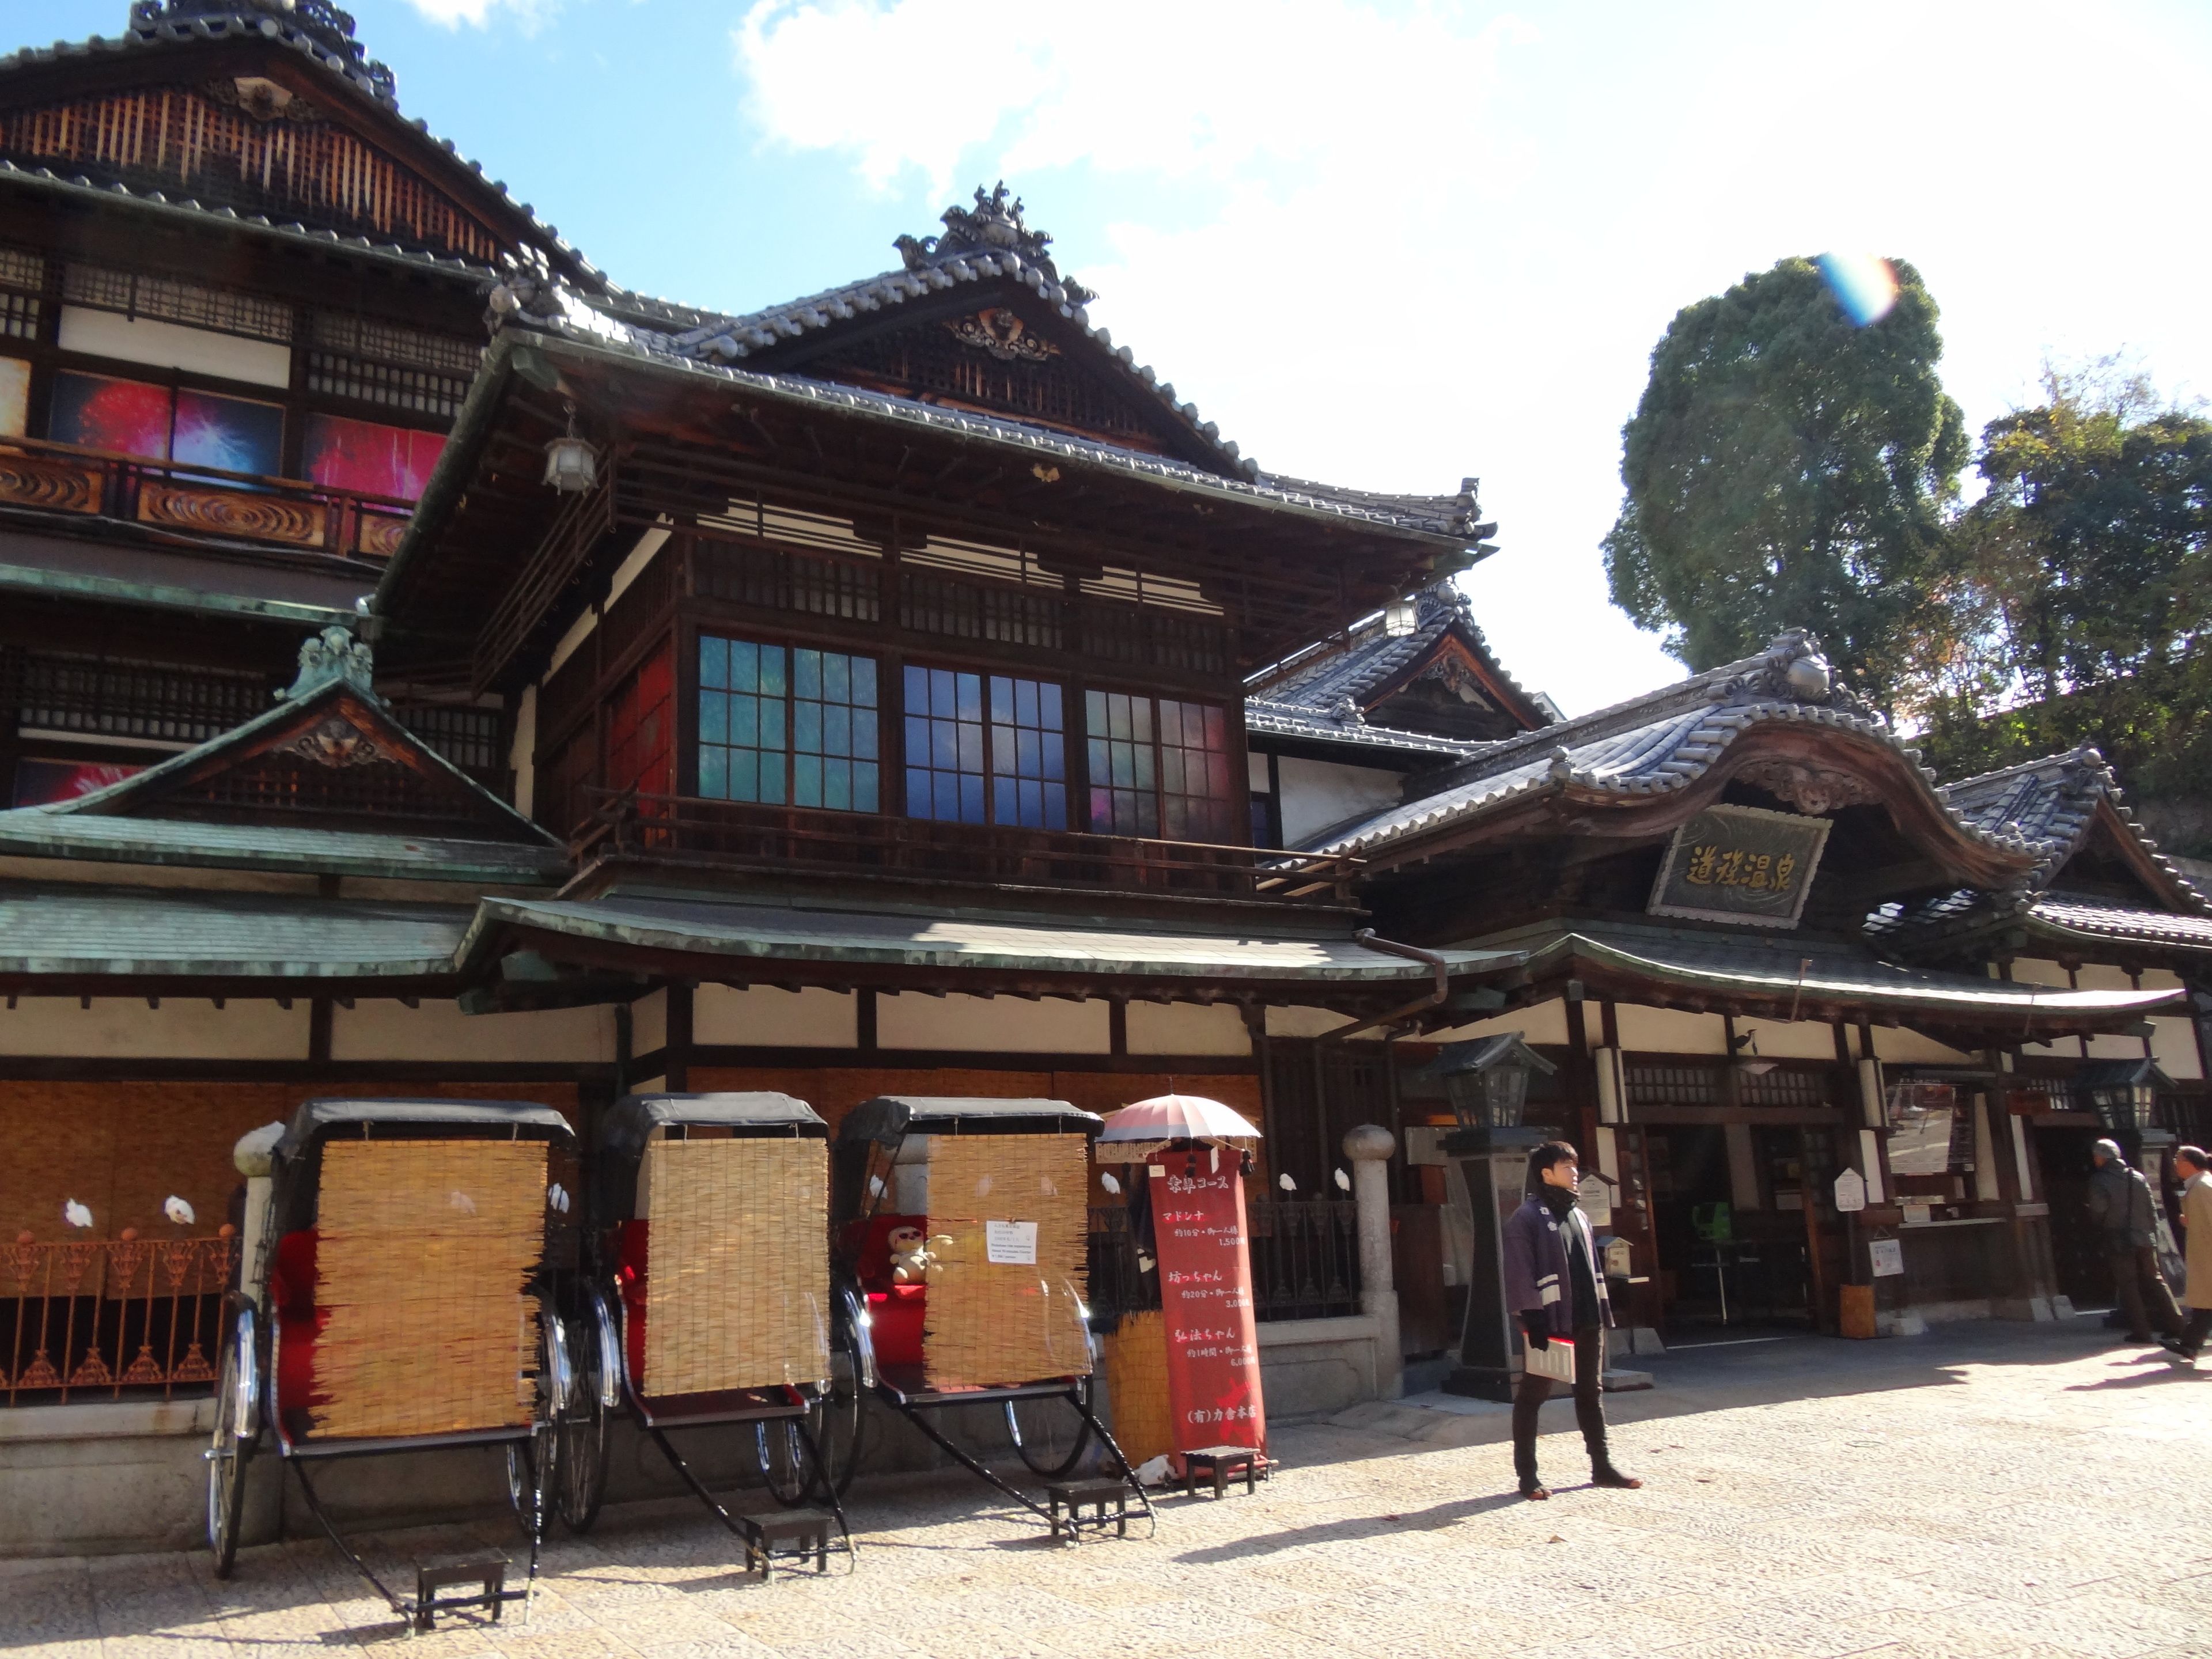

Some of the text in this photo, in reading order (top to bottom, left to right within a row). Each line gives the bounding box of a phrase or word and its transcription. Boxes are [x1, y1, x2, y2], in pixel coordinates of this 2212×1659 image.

[1686, 846, 1796, 891] 道後温泉
[1162, 1210, 1204, 1222] マドンナ
[1168, 1270, 1222, 1283] 坊っちゃん
[1175, 1327, 1236, 1342] 弘法ちゃん
